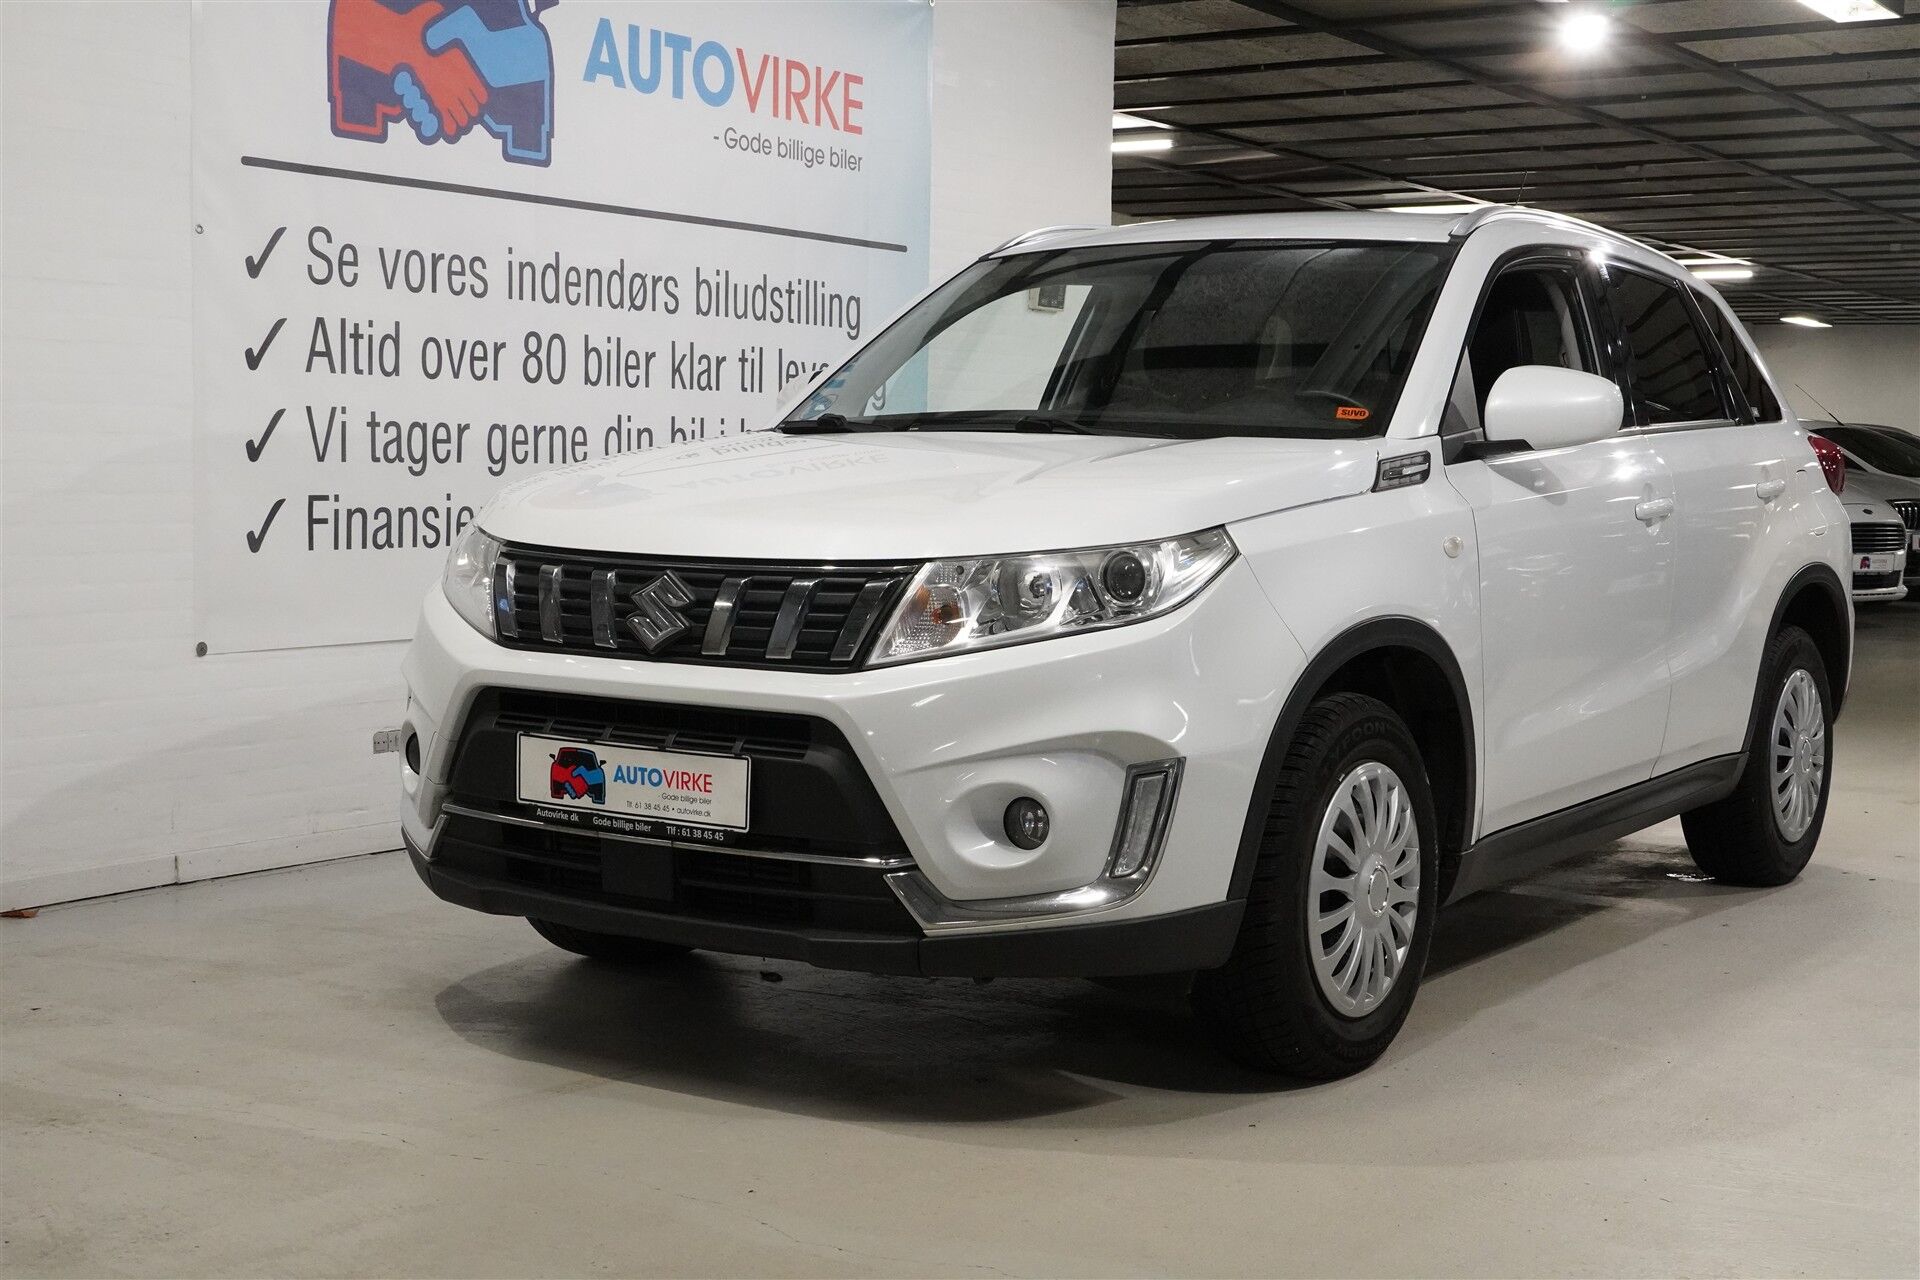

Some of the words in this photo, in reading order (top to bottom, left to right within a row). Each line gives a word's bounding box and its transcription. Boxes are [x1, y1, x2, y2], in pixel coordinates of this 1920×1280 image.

[582, 17, 864, 135] AUTOVIRKE
[724, 127, 772, 155] Gode
[778, 133, 825, 168] billige
[829, 147, 863, 172] biler
[307, 225, 359, 287] Se
[378, 247, 489, 298] vores
[507, 247, 680, 315] indendørs
[695, 266, 861, 340] biludstilling
[305, 316, 400, 377] Altid
[421, 336, 507, 381] over
[522, 331, 567, 385] 80
[584, 334, 656, 388] biler
[671, 340, 727, 391] klar
[738, 346, 763, 393] til
[305, 405, 347, 463] Vi
[366, 410, 470, 476] tager
[487, 423, 588, 477] gerne
[604, 414, 654, 456] din
[307, 493, 475, 551] Finansie
[613, 764, 713, 793] AUTOVIRKE
[661, 792, 679, 801] Gode
[680, 795, 698, 804] billige
[699, 797, 712, 805] biler
[536, 808, 569, 821] Autovirke
[592, 816, 612, 827] Gode
[612, 818, 634, 832] billige
[635, 821, 652, 832] biler
[681, 828, 691, 837] 61
[692, 829, 702, 838] 38
[703, 830, 713, 840] 45
[714, 832, 724, 841] 45
[644, 802, 652, 810] 38
[653, 803, 661, 811] 45
[676, 807, 712, 817] autovirke.dk
